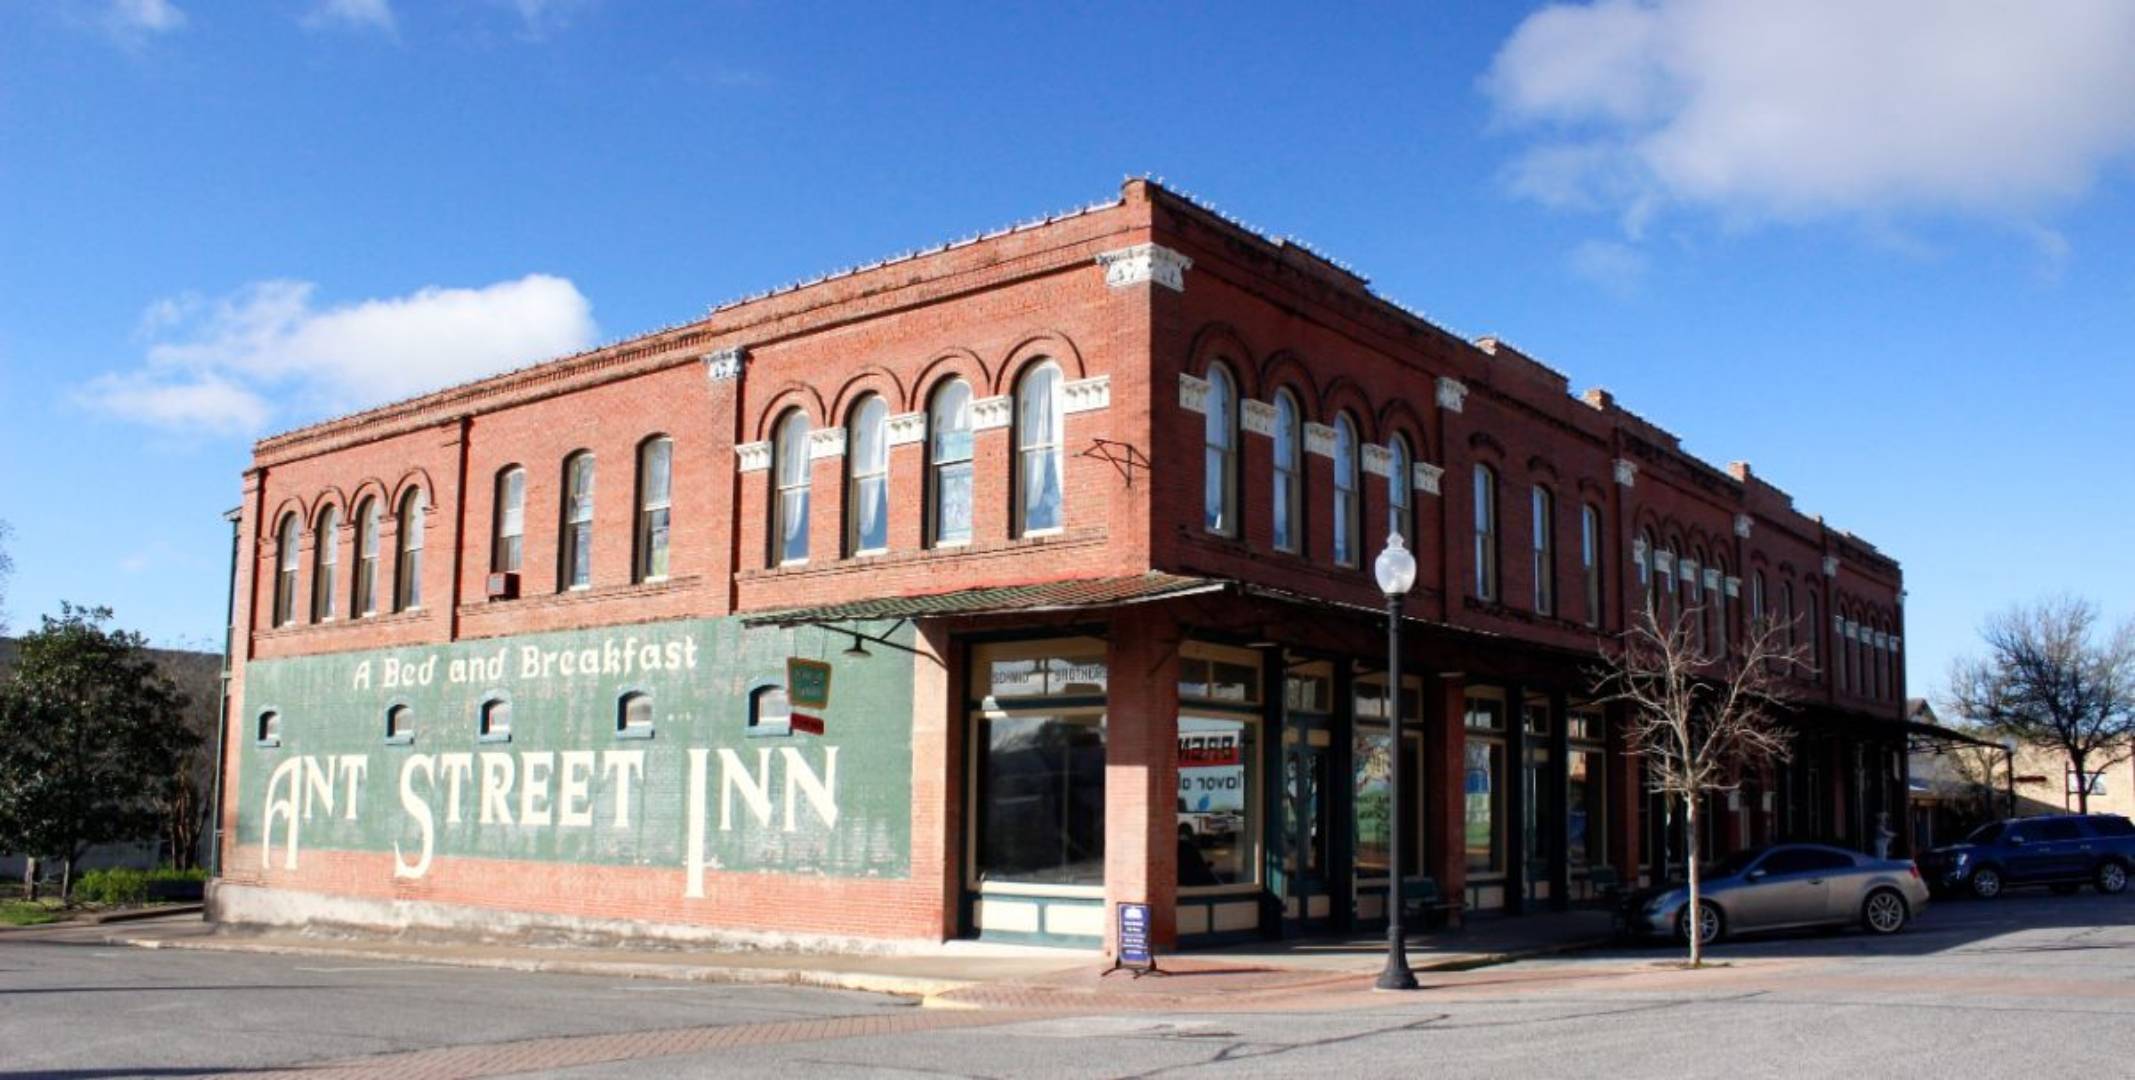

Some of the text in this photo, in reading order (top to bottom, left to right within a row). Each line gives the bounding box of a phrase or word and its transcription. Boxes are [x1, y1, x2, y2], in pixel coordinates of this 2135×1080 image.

[353, 635, 699, 690] A Bed and Breakfast
[262, 746, 839, 898] ANT STREET INN
